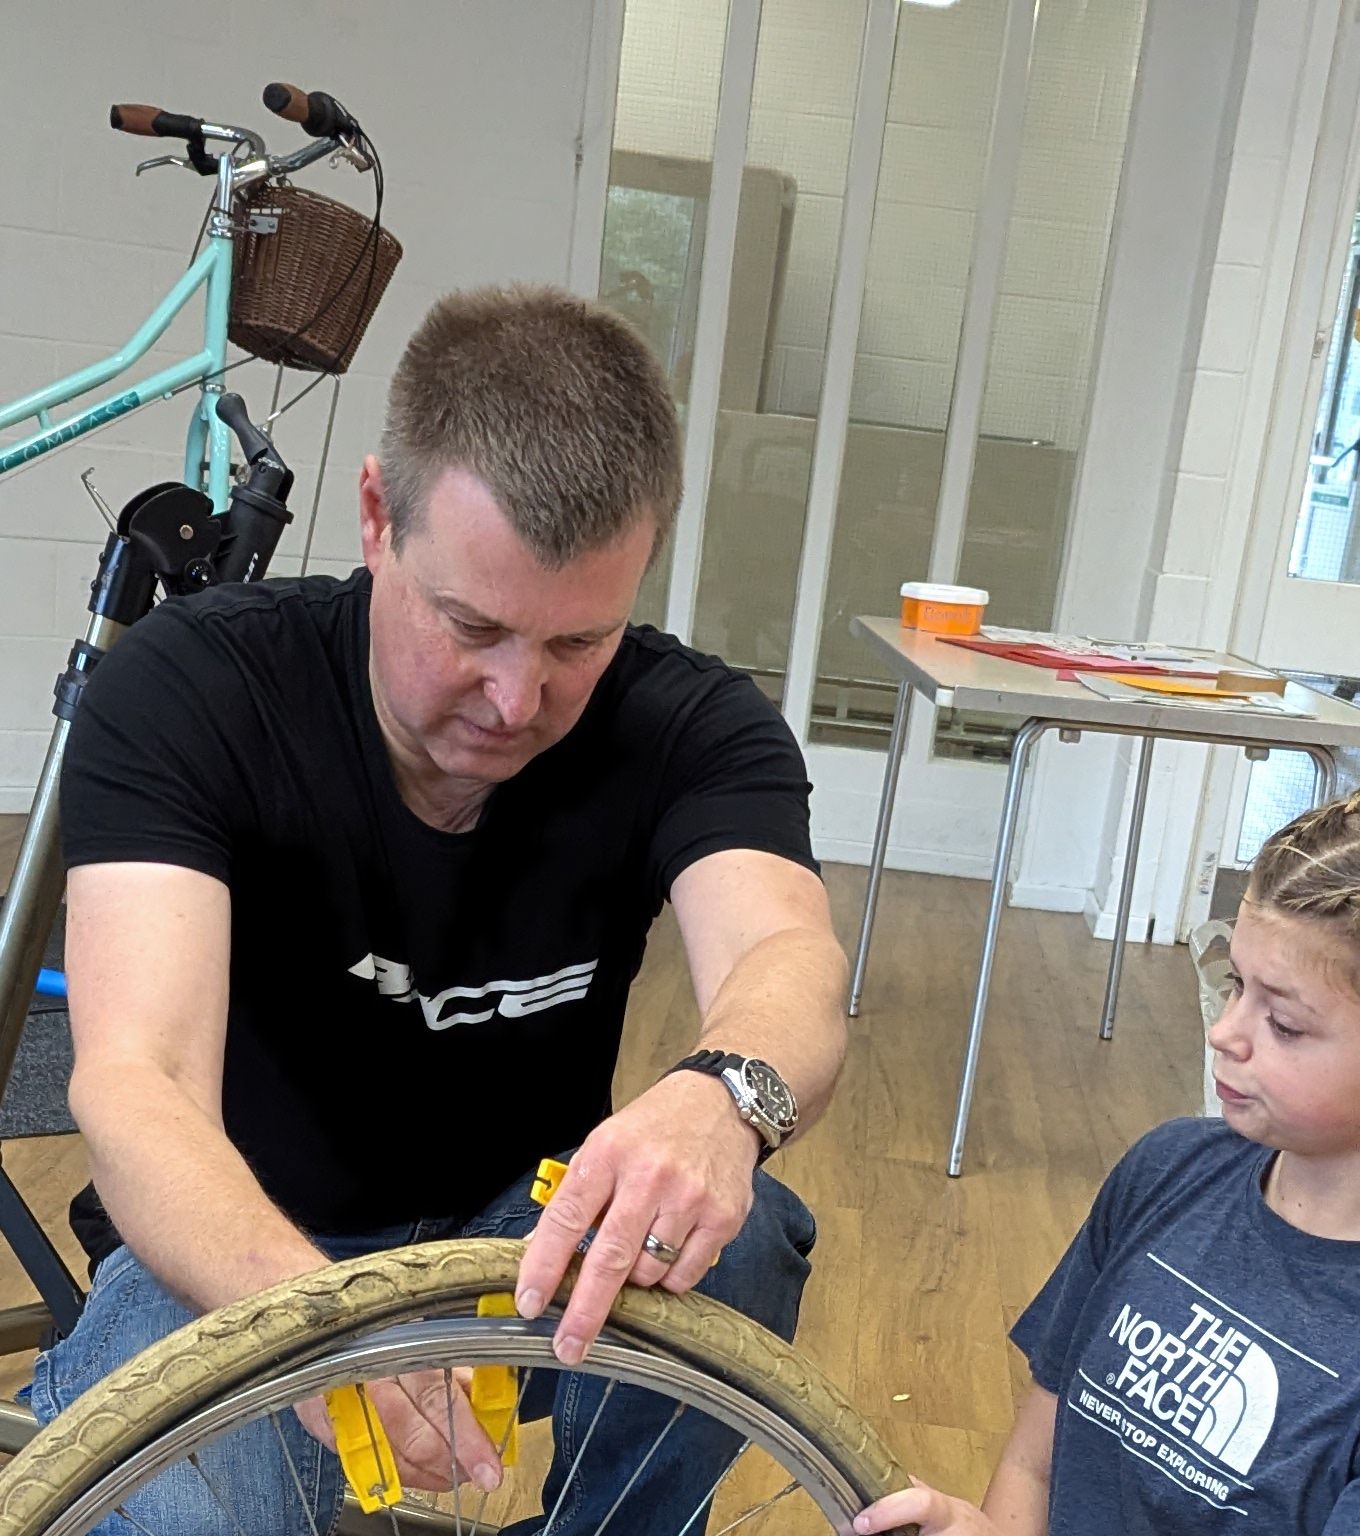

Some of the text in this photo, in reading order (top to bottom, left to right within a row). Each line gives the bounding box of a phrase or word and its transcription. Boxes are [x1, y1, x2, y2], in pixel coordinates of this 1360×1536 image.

[2, 396, 136, 470] COMPASS
[1108, 1303, 1230, 1403] NORTH
[1180, 1302, 1252, 1371] THE
[1114, 1355, 1207, 1437] FACE
[1079, 1389, 1122, 1424] NEVER
[1156, 1444, 1230, 1501] EXPLORING
